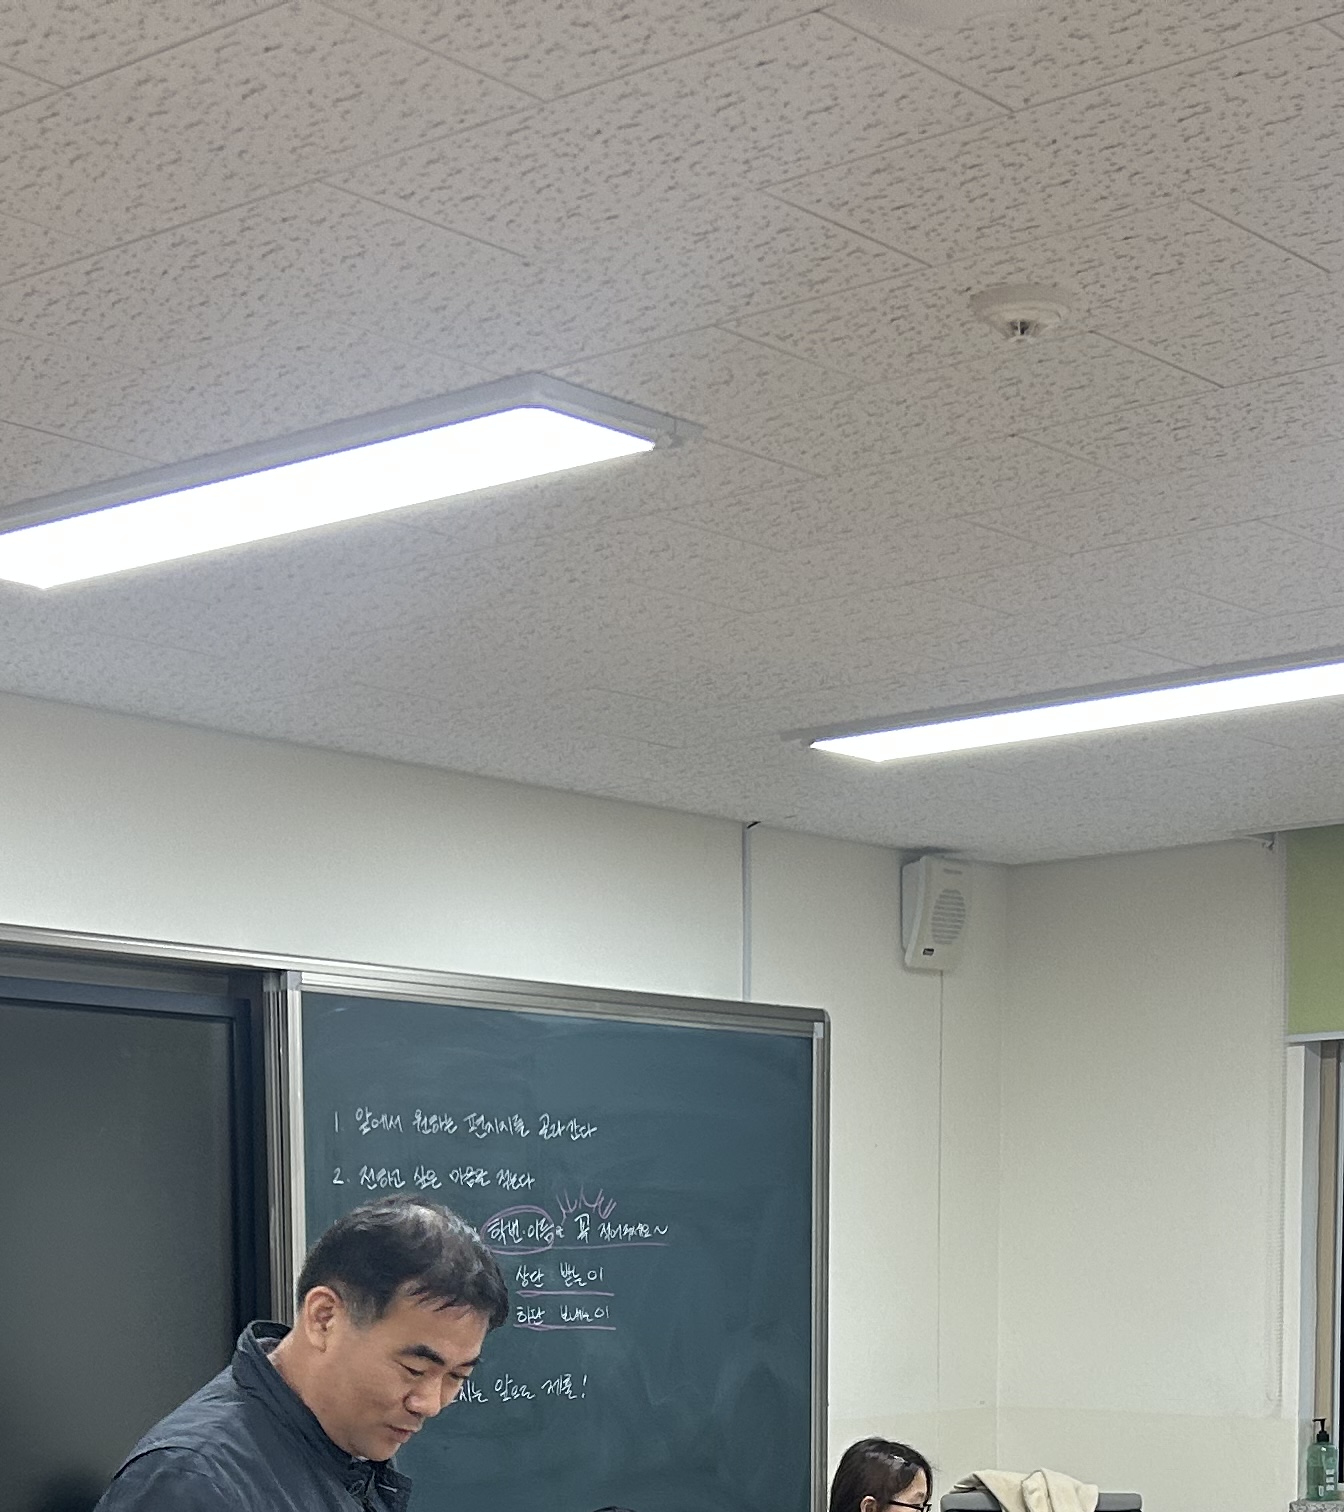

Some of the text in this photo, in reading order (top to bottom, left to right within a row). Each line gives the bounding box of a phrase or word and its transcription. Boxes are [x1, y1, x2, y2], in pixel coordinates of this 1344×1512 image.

[355, 1106, 404, 1136] 앞에서
[412, 1108, 458, 1135] 원하는
[463, 1112, 531, 1139] 편지지를
[332, 1165, 536, 1191] 2. 전하고 싶은 마음을 적는다
[574, 1213, 591, 1244] 꼭
[516, 1265, 545, 1288] 상단
[516, 1306, 546, 1326] 하단
[494, 1373, 536, 1402] 앞으로
